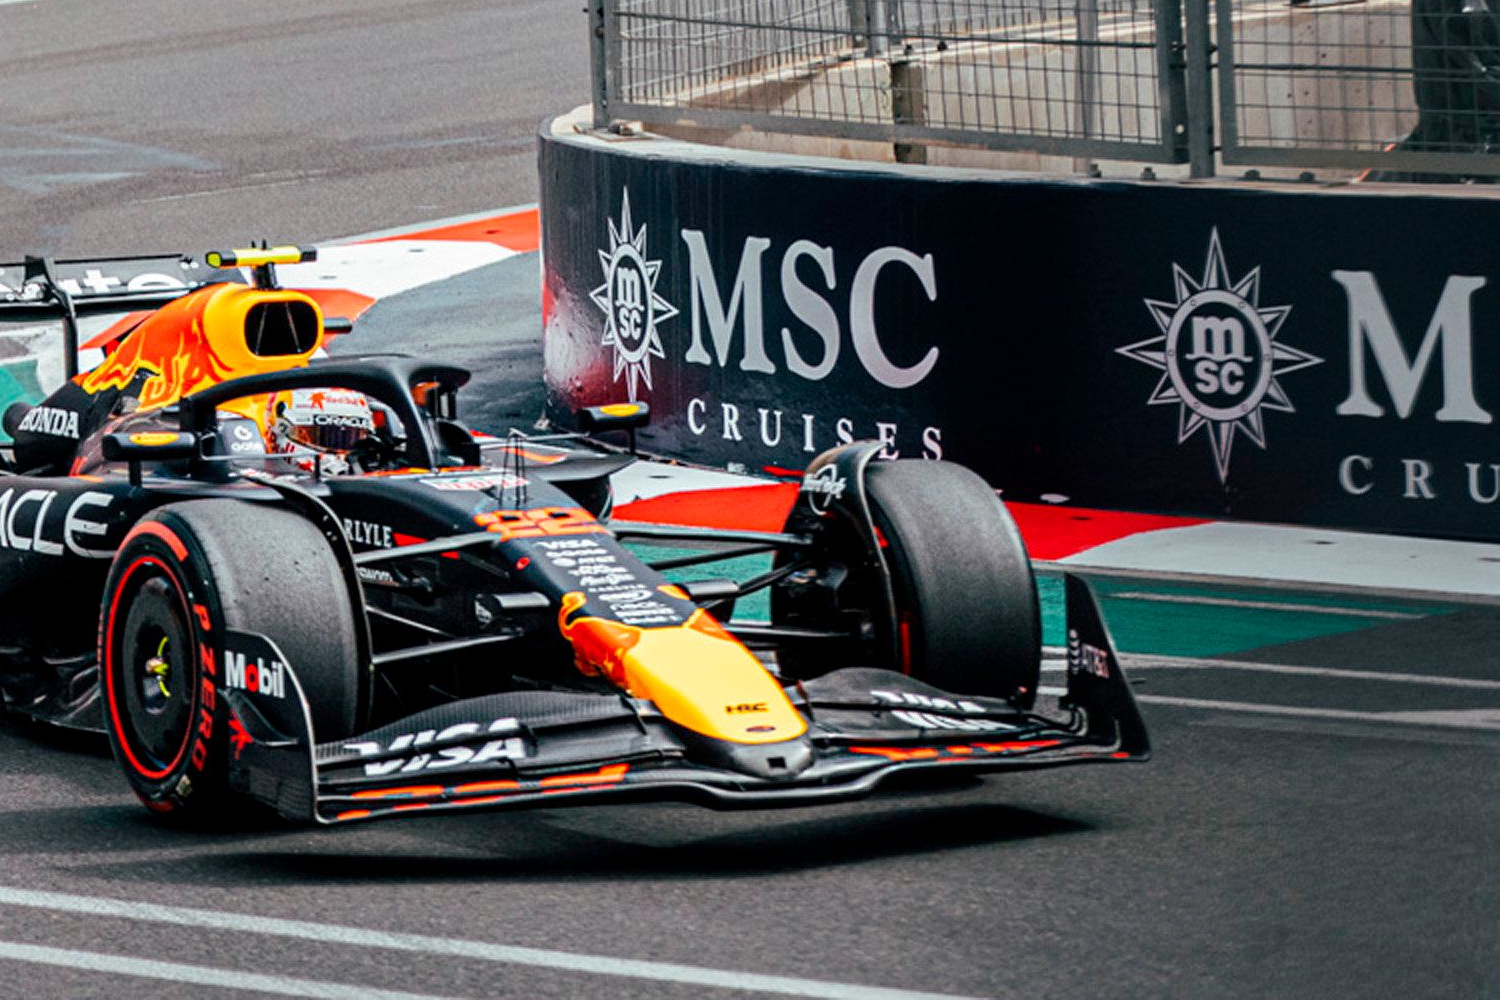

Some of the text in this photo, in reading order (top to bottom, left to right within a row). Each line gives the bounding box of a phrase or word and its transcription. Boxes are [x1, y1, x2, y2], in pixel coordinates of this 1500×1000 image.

[681, 228, 939, 389] MSC
[687, 398, 943, 462] CRUISES
[343, 518, 393, 548] RLYLE
[224, 650, 286, 699] Mobil
